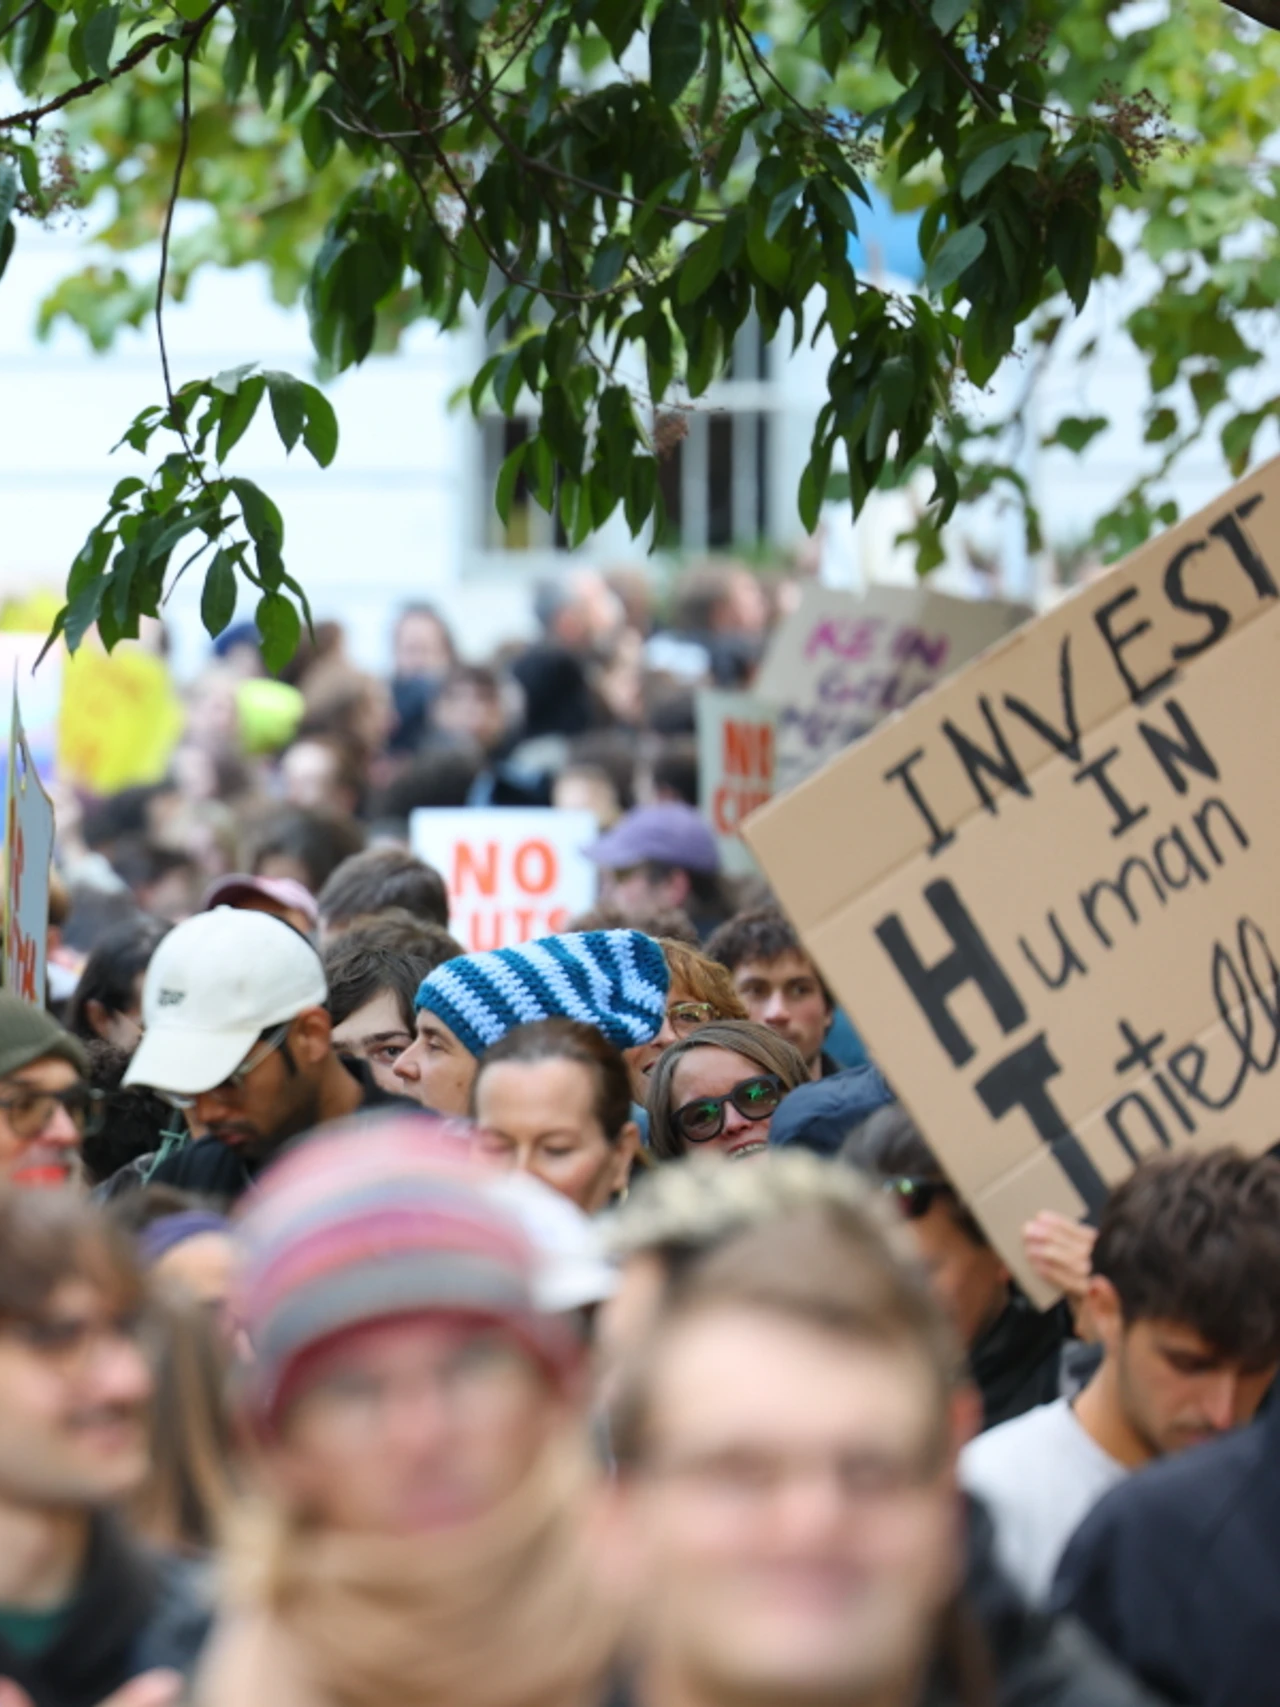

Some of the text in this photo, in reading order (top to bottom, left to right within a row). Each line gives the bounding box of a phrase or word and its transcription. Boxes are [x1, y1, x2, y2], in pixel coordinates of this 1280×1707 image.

[883, 492, 1279, 860] INVEST
[1072, 698, 1219, 838] IN
[450, 905, 570, 953] UTS
[453, 839, 557, 896] NO
[874, 795, 1250, 1068] Human
